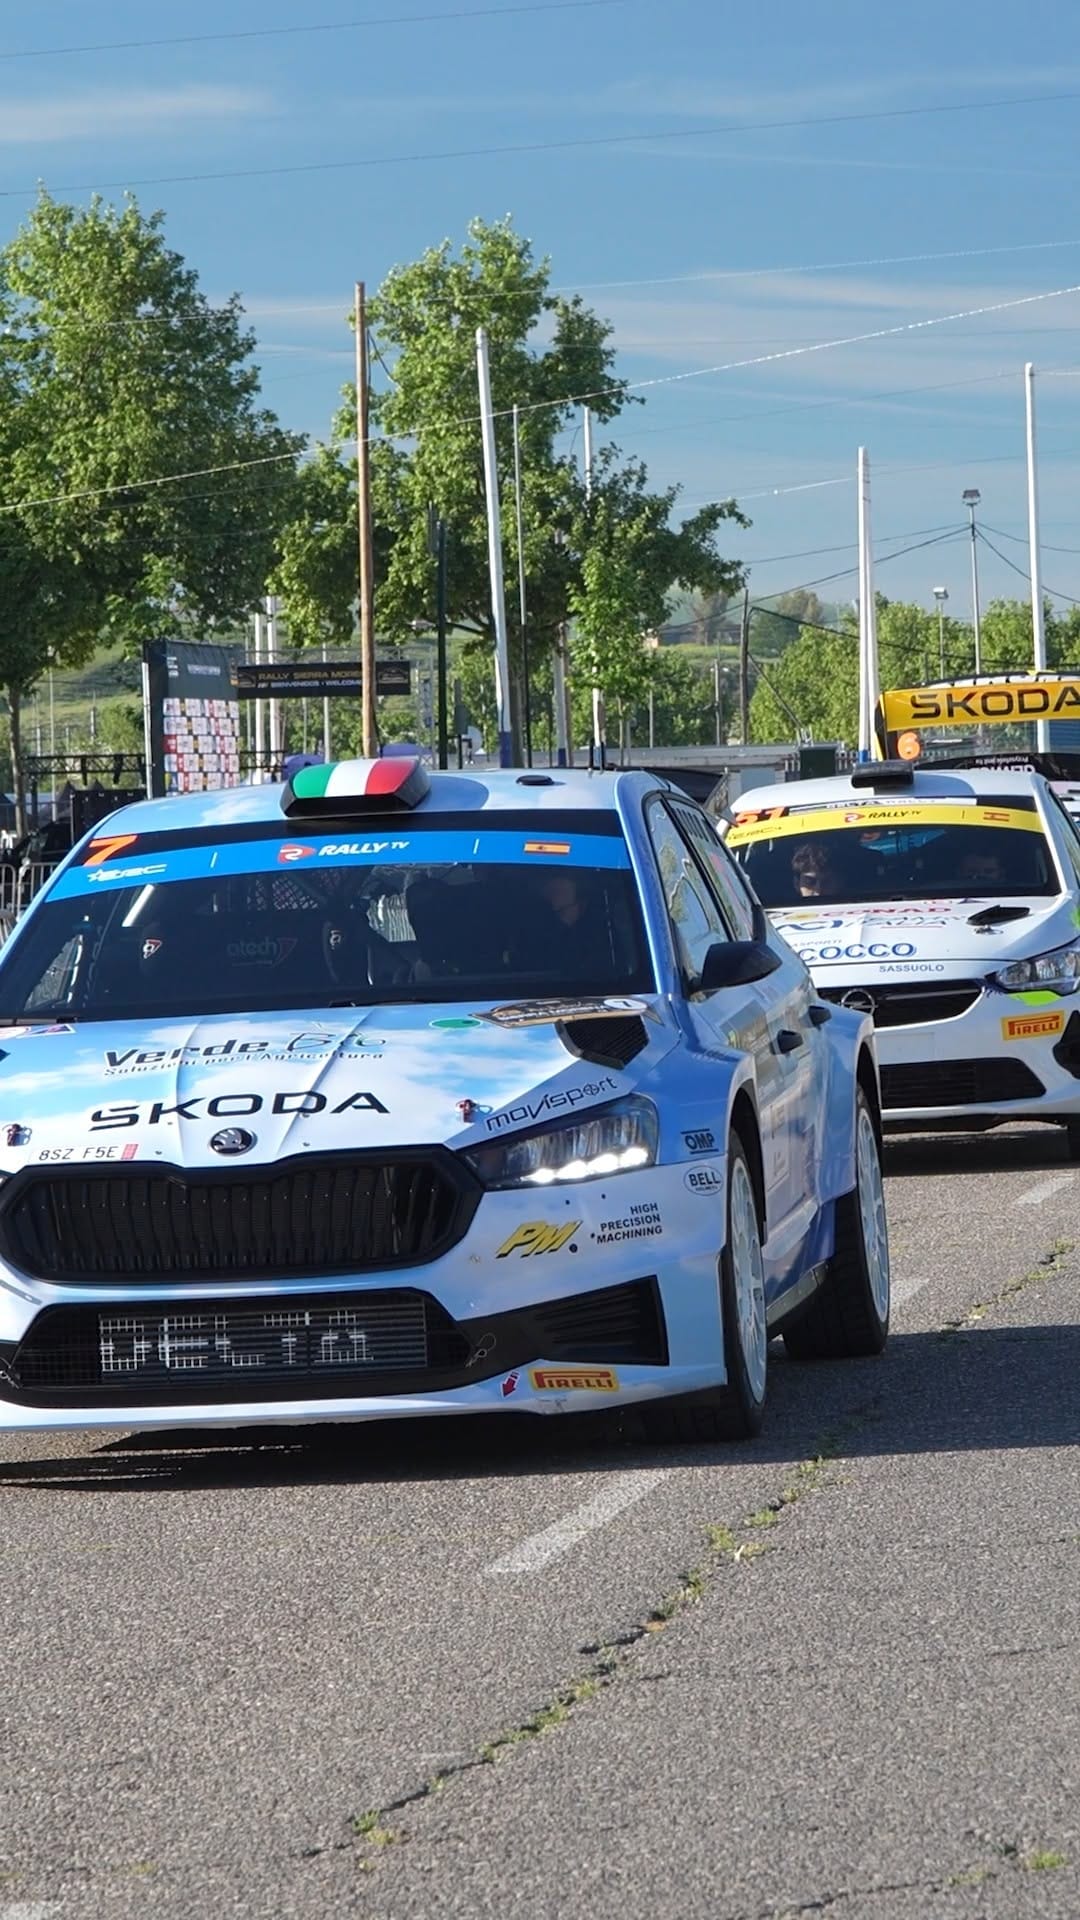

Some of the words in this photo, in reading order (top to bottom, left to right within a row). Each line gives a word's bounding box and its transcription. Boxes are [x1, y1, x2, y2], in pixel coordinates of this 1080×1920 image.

[258, 671, 289, 680] RALLY
[293, 670, 329, 680] SIERRA
[897, 731, 921, 760] 6
[867, 810, 909, 819] RALLY
[83, 833, 138, 866] 7
[318, 842, 389, 856] RALLY
[391, 841, 410, 849] TV
[822, 906, 951, 917] CONAD
[879, 964, 944, 973] SASSUOLO
[1007, 1015, 1060, 1036] PIRELLI
[106, 1039, 269, 1067] Verde
[104, 1060, 197, 1076] Soluzioni
[486, 1077, 617, 1131] movisport
[684, 1132, 715, 1150] OMP
[689, 1171, 721, 1187] BELL
[630, 1202, 659, 1215] HIGH
[600, 1213, 661, 1232] PRECISION
[496, 1220, 583, 1259] PM
[597, 1225, 663, 1244] MACHINING
[534, 1371, 613, 1388] PIRELLI
